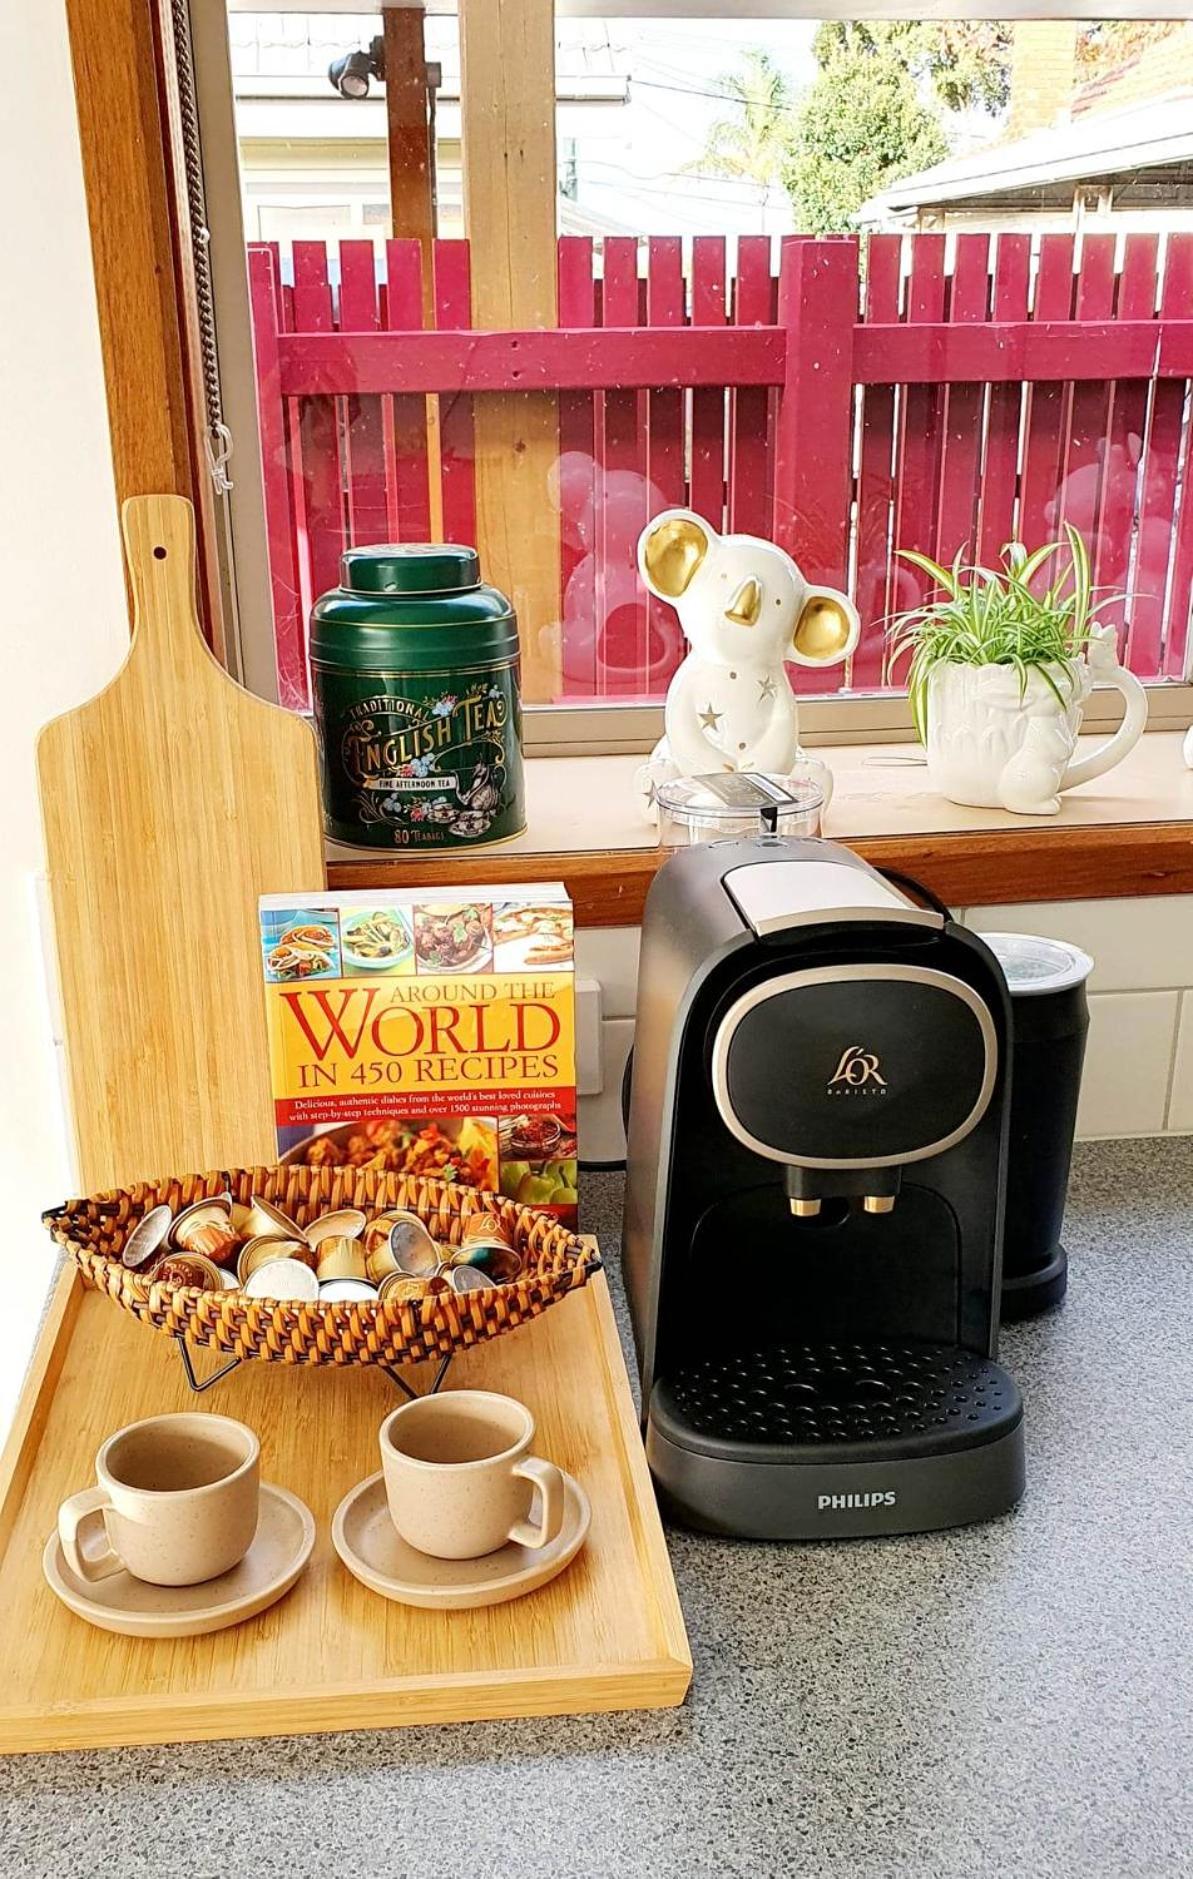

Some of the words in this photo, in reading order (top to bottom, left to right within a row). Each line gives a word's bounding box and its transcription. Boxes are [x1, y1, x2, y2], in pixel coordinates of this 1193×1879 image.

[351, 698, 428, 722] TRADITIONAL
[346, 717, 451, 778] ENGLISH
[452, 695, 507, 743] TEA
[379, 780, 393, 788] FINE
[396, 780, 436, 788] AFTERNOON
[438, 779, 451, 788] TEA
[394, 829, 410, 843] 80
[390, 983, 497, 1003] AROUND
[504, 982, 556, 1000] THE
[279, 988, 561, 1061] WORLD
[297, 1063, 337, 1088] IN
[350, 1060, 403, 1085] 450
[414, 1054, 559, 1081] RECIPES
[295, 1099, 337, 1109] Delicious,
[340, 1096, 378, 1106] authentic
[381, 1095, 407, 1105] dishes
[409, 1094, 430, 1103] from
[431, 1093, 445, 1102] the
[447, 1091, 477, 1101] world's
[479, 1091, 496, 1101] best
[498, 1090, 521, 1100] loved
[523, 1090, 556, 1099] cuisines
[289, 1111, 308, 1121] with
[310, 1108, 361, 1120] step-by-step
[363, 1107, 408, 1117] techniques
[410, 1105, 427, 1114] and
[450, 1104, 469, 1113] 1500
[471, 1103, 508, 1113] stunning
[509, 1101, 561, 1112] photographs
[818, 1491, 896, 1510] PHILIPS
